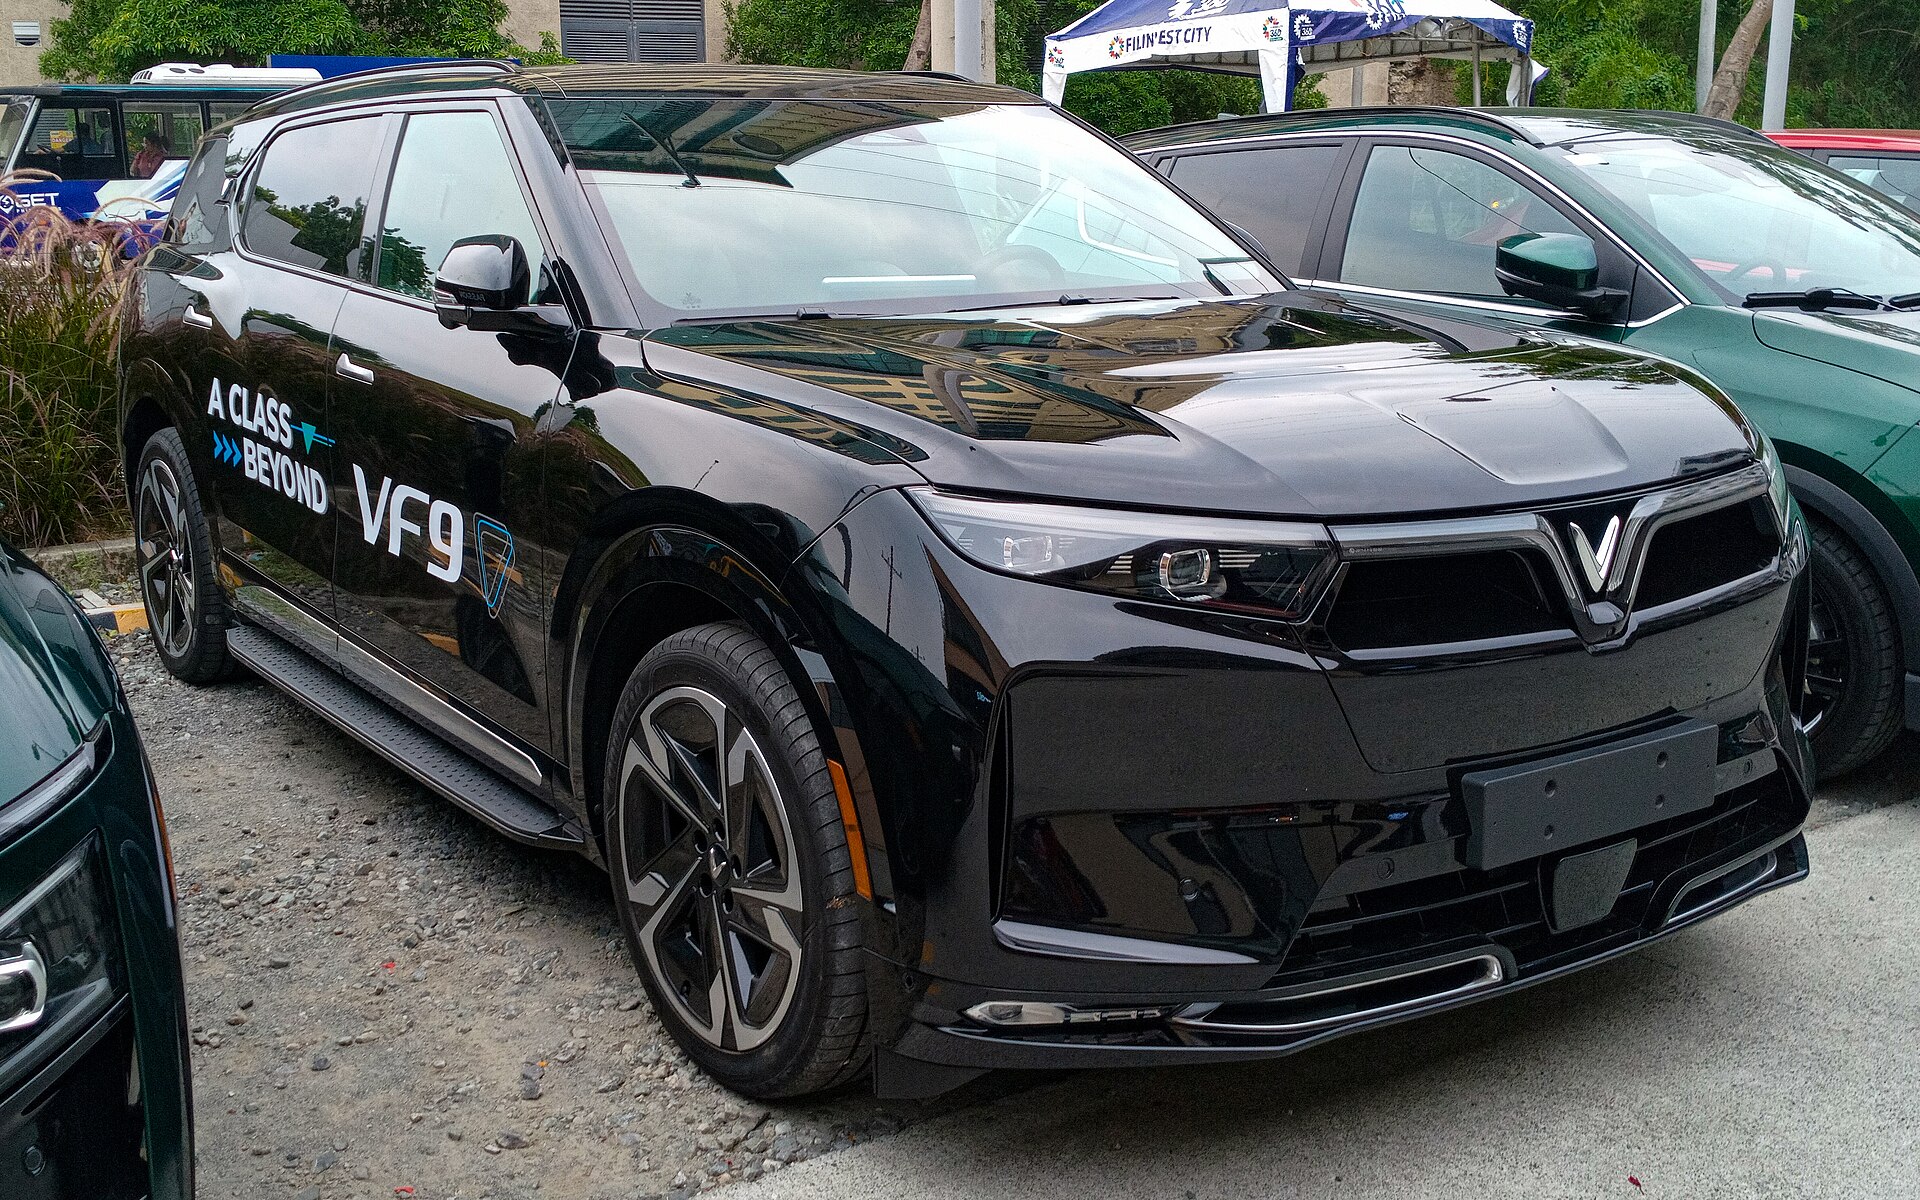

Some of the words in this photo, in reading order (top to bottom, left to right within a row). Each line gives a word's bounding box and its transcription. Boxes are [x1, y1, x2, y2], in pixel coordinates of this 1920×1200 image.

[1184, 25, 1212, 44] CITY
[207, 377, 226, 420] A
[228, 383, 294, 450] CLASS
[242, 436, 329, 516] BEYOND
[352, 462, 465, 584] VF9
